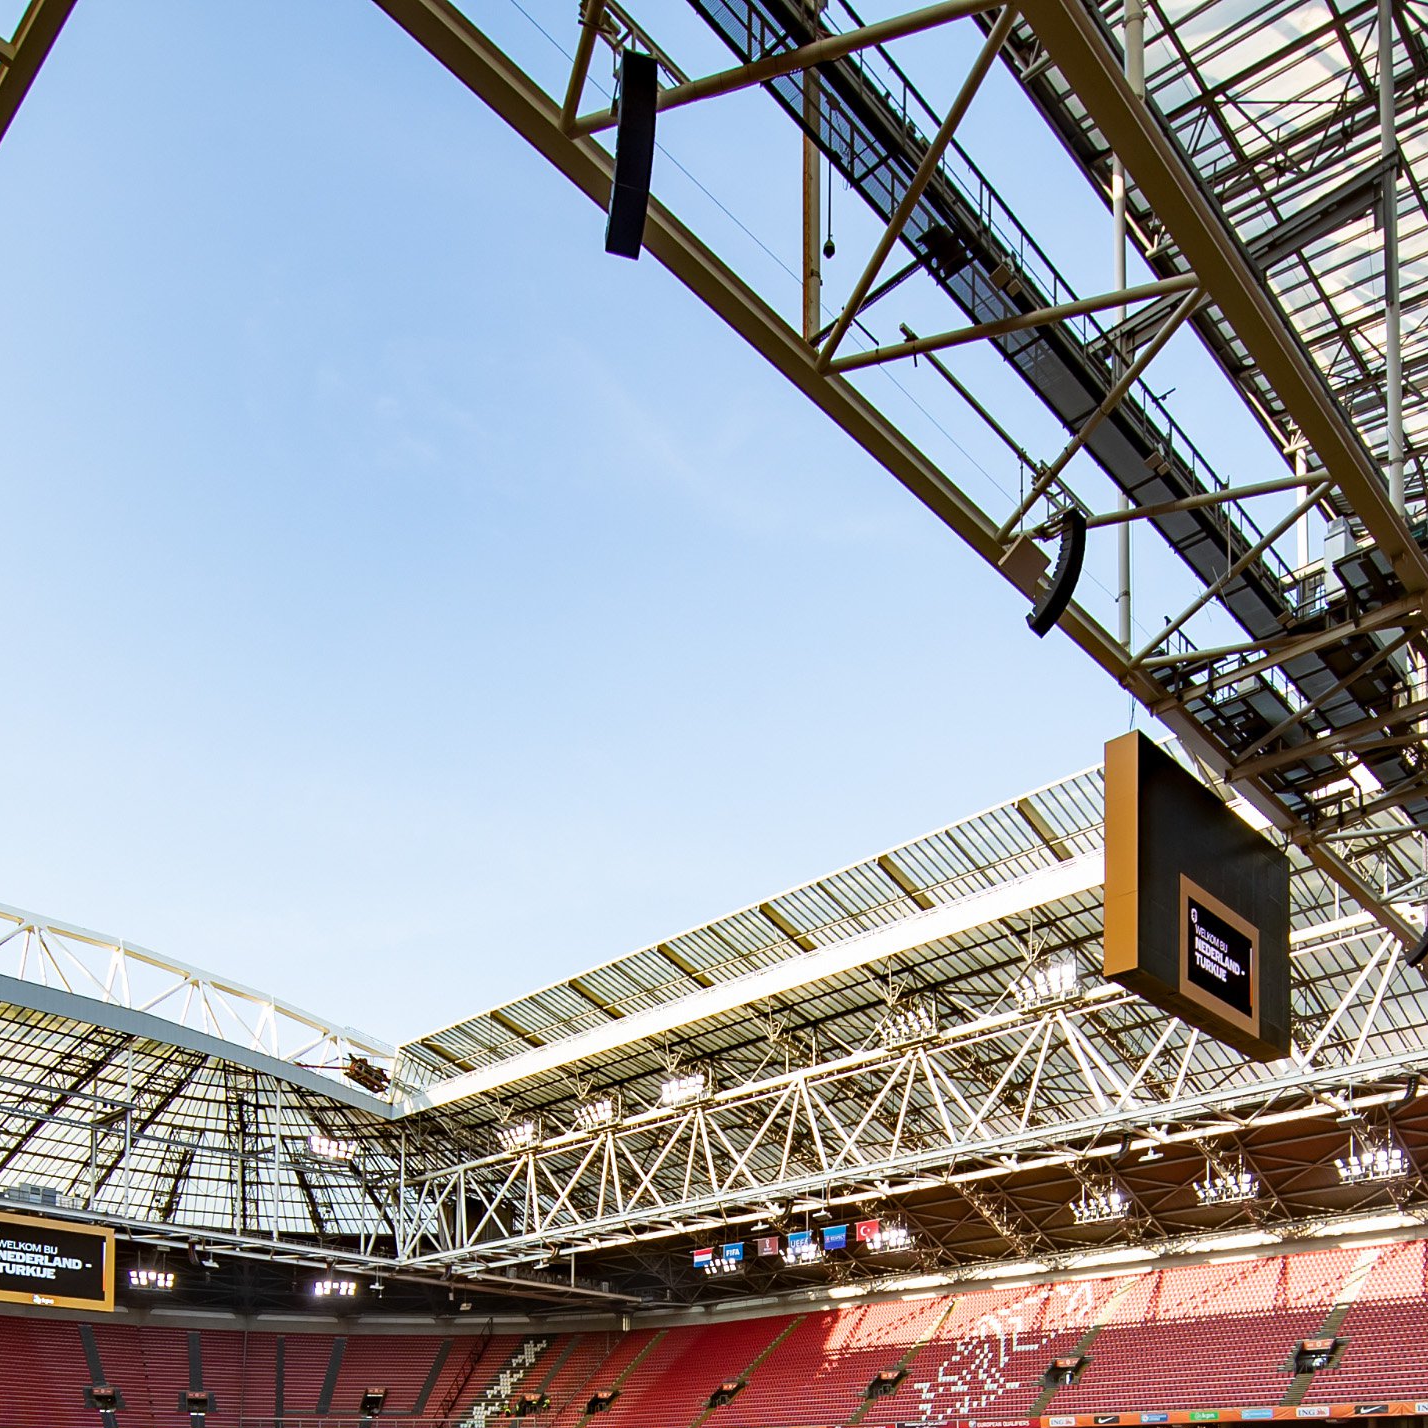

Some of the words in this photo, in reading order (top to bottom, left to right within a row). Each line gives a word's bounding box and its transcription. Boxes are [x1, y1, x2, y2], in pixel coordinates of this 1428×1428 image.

[1195, 924, 1220, 950] WELKOM
[1194, 937, 1241, 977] NEDERLAND
[1194, 952, 1227, 983] TURKIJE
[43, 1244, 58, 1255] BIJ
[725, 1248, 740, 1257] FIFA
